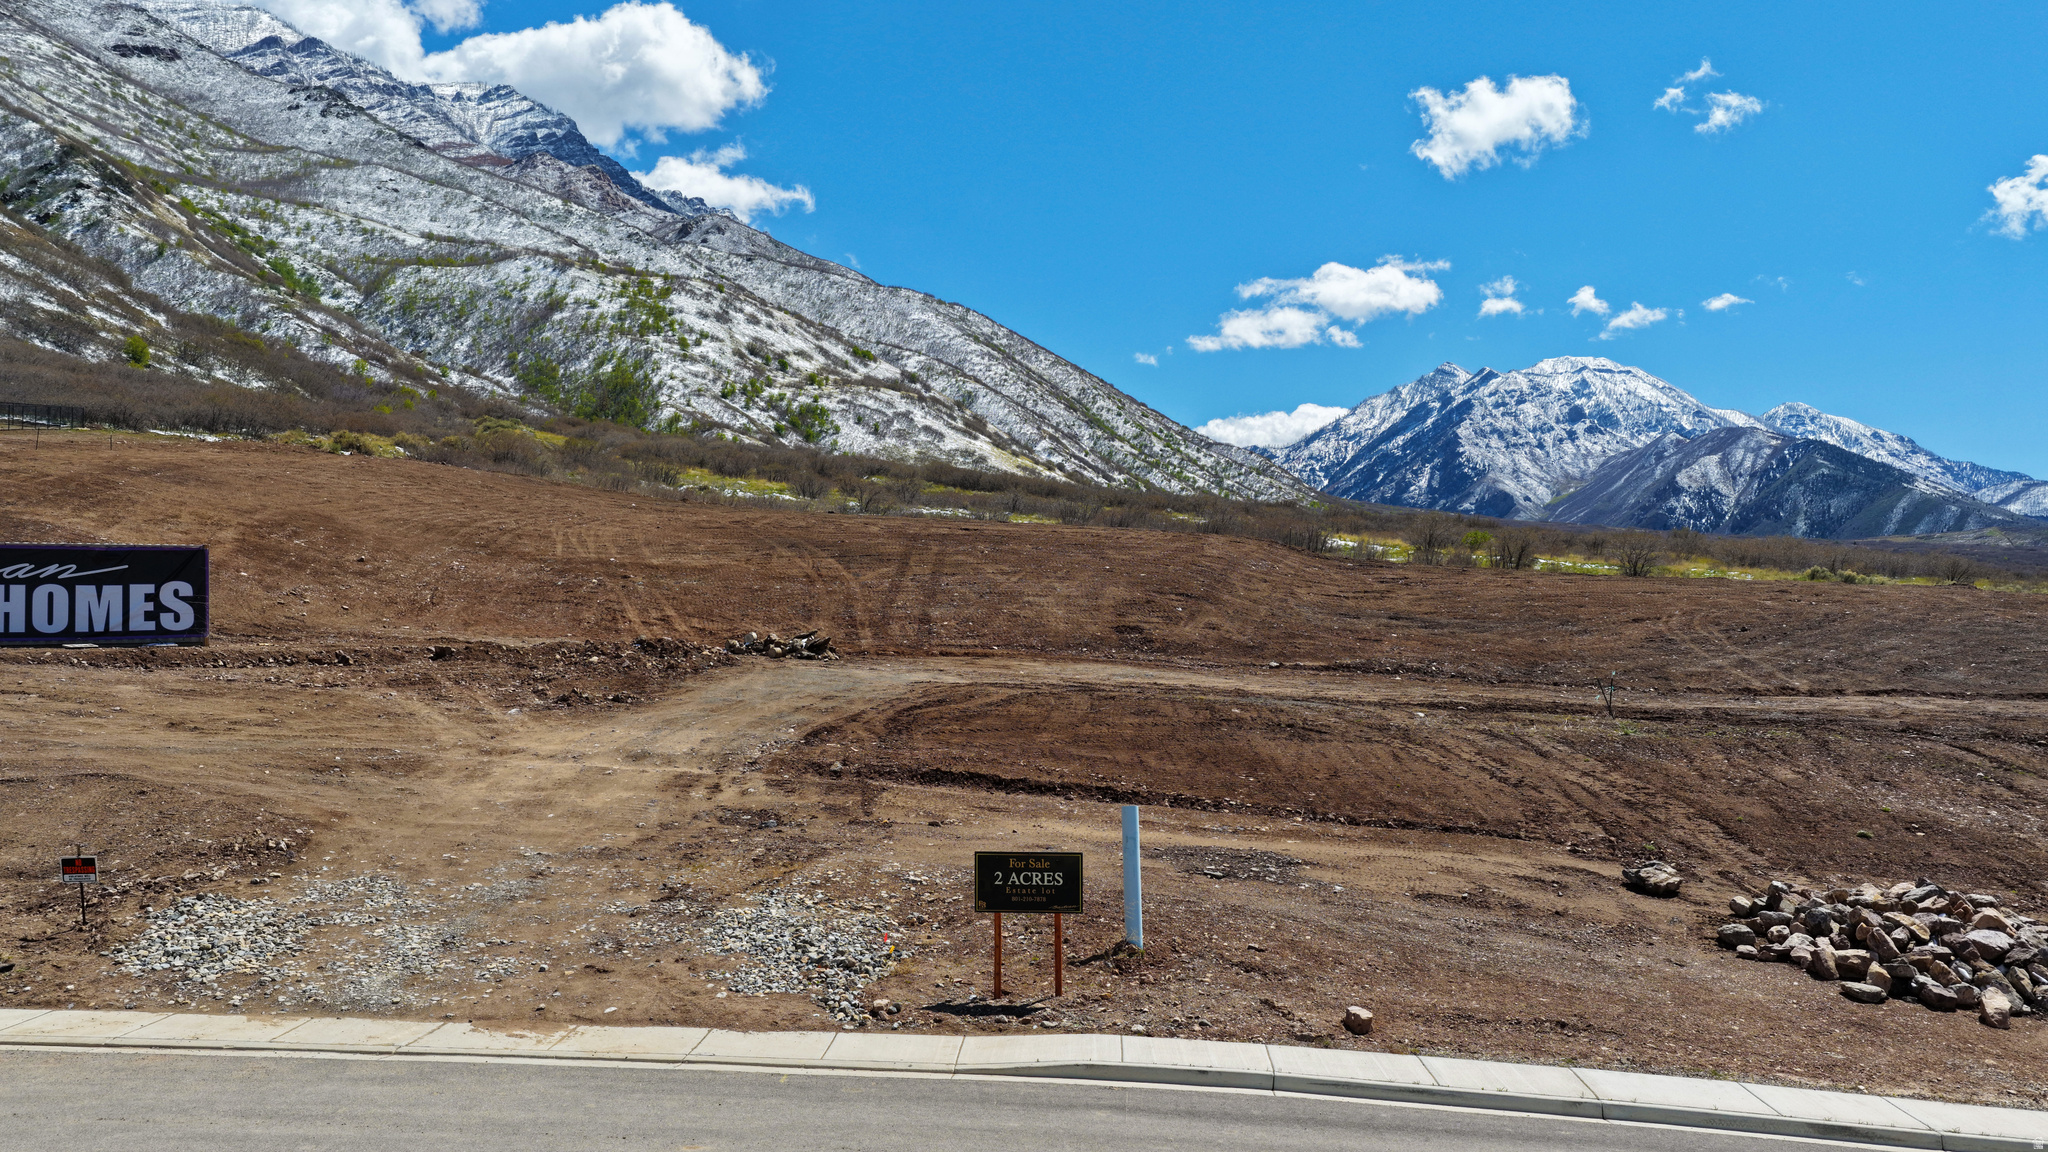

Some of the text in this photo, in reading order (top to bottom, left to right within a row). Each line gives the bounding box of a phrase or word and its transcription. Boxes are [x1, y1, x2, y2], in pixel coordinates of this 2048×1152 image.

[0, 581, 195, 634] HOMES
[1009, 858, 1050, 868] For Sale
[994, 872, 1063, 886] 2 ACRES
